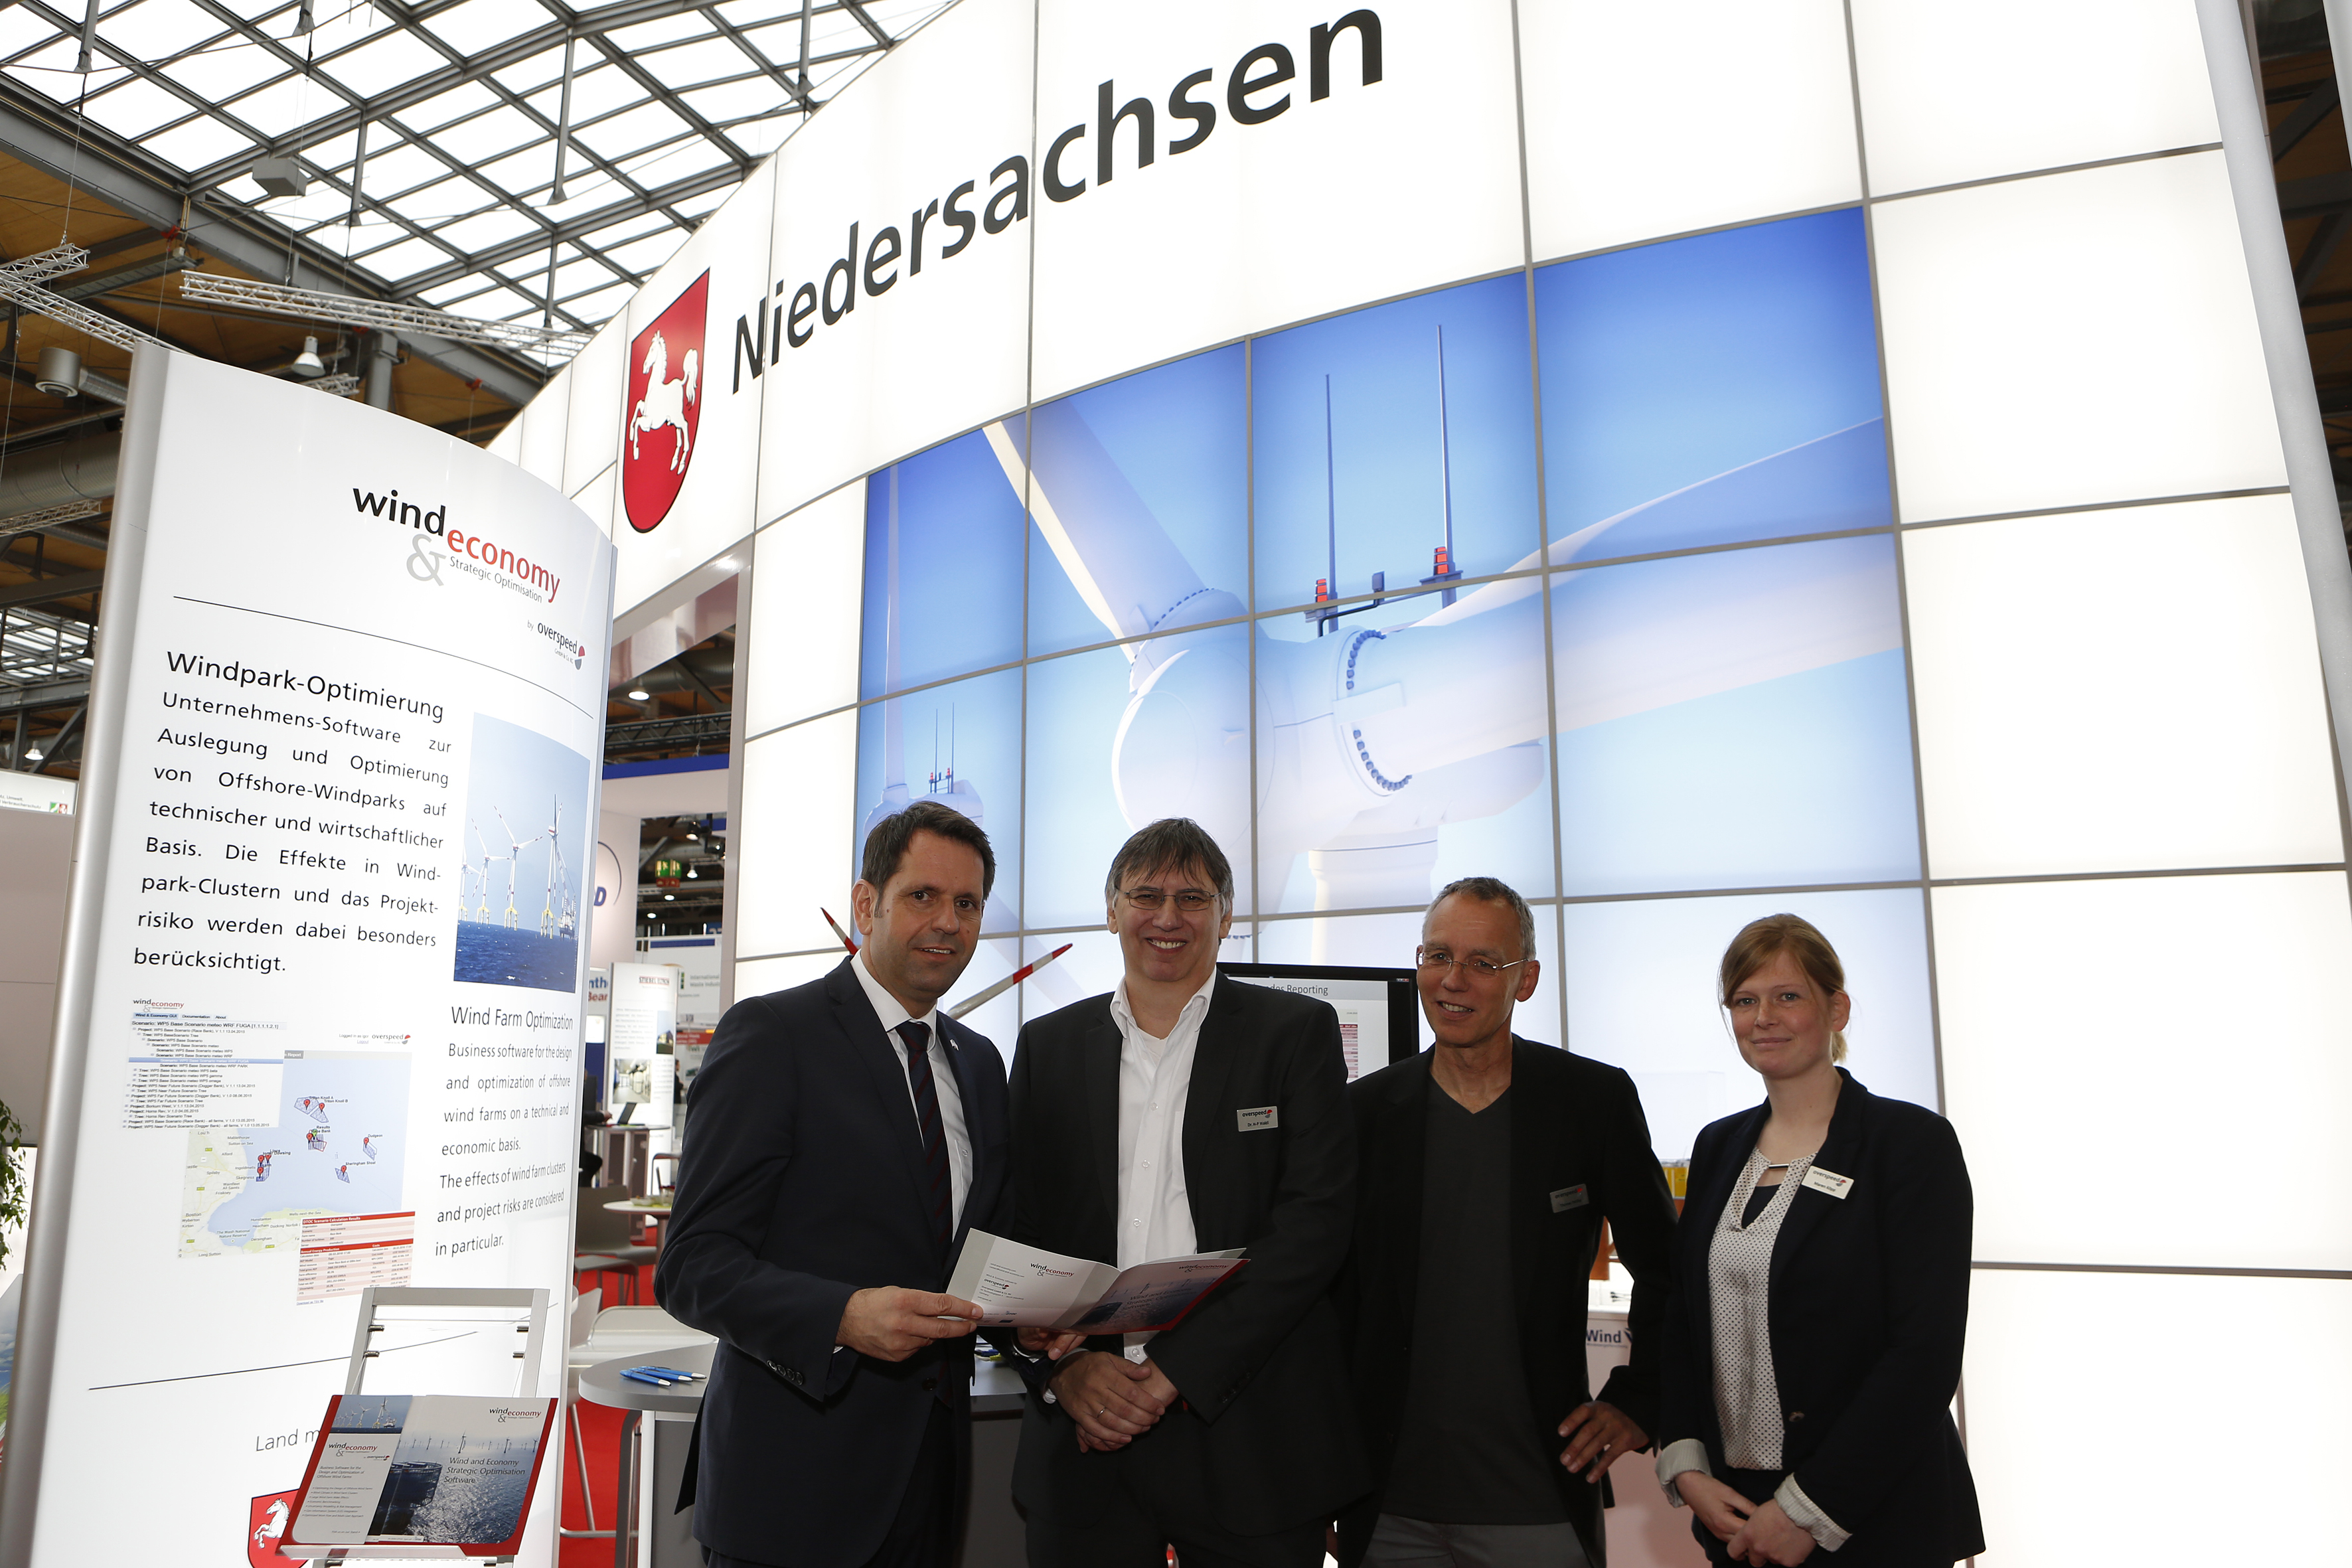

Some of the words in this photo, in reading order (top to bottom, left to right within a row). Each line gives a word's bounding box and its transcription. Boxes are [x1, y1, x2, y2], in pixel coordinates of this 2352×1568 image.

[732, 8, 1383, 395] Niedersachsen
[353, 487, 445, 536] wind
[447, 529, 560, 603] economy
[449, 556, 491, 582] Strategic
[495, 573, 542, 603] Optimisation
[528, 620, 534, 631] by
[538, 623, 577, 654] overspeed
[167, 651, 444, 724] Windpark-Optimierung
[163, 692, 401, 743] Unternehmens-Software
[429, 740, 451, 752] zur
[157, 728, 267, 759] Auslegung
[293, 749, 327, 764] und
[351, 755, 448, 788] Optimierung
[154, 767, 191, 783] von
[219, 772, 404, 810] Offshore-Windparks
[424, 803, 447, 817] auf
[149, 801, 268, 826] technischer
[275, 817, 311, 832] und
[319, 821, 443, 848] wirtschaftlicher
[146, 836, 201, 856] Basis.
[226, 844, 258, 862] Die
[279, 850, 346, 870] Effekte
[365, 858, 378, 874] in
[397, 863, 440, 880] Wind-
[141, 876, 279, 899] park-Clustern
[295, 888, 329, 903] und
[342, 890, 369, 907] das
[381, 895, 437, 915] Projekt-
[138, 911, 193, 929] risiko
[207, 918, 282, 935] werden
[296, 921, 346, 939] dabei
[358, 926, 435, 947] besonders
[133, 947, 285, 975] berücksichtigt.
[1287, 984, 1328, 996] Reporting
[451, 1006, 490, 1025] Wind
[495, 1009, 522, 1026] Farm
[526, 1011, 573, 1032] Optimization
[449, 1044, 495, 1057] Business
[498, 1044, 533, 1058] software
[535, 1044, 544, 1058] for
[546, 1045, 555, 1058] the
[556, 1046, 572, 1061] design
[447, 1075, 469, 1089] and
[478, 1075, 534, 1092] optimization
[538, 1075, 546, 1087] of
[550, 1074, 570, 1087] offshore
[444, 1107, 473, 1122] wind
[479, 1107, 506, 1121] farms
[510, 1109, 520, 1119] on
[524, 1109, 528, 1119] a
[532, 1103, 558, 1118] technical
[560, 1103, 569, 1115] and
[442, 1139, 495, 1155] economic
[499, 1137, 520, 1151] basis.
[440, 1174, 462, 1188] The
[465, 1171, 499, 1186] effects
[501, 1168, 510, 1182] of
[512, 1166, 530, 1181] wind
[532, 1164, 546, 1178] farm
[547, 1162, 566, 1175] clusters
[1813, 1170, 1840, 1182] overspeed
[437, 1206, 461, 1222] and
[465, 1203, 501, 1223] project
[503, 1198, 520, 1214] risks
[522, 1199, 533, 1210] are
[535, 1188, 564, 1207] considered
[436, 1242, 446, 1256] in
[452, 1233, 503, 1257] particular.
[984, 1278, 1004, 1287] overspeed
[1046, 1268, 1074, 1277] economy
[1587, 1330, 1621, 1343] Wind
[256, 1429, 298, 1452] Land
[447, 1466, 477, 1476] Strategic
